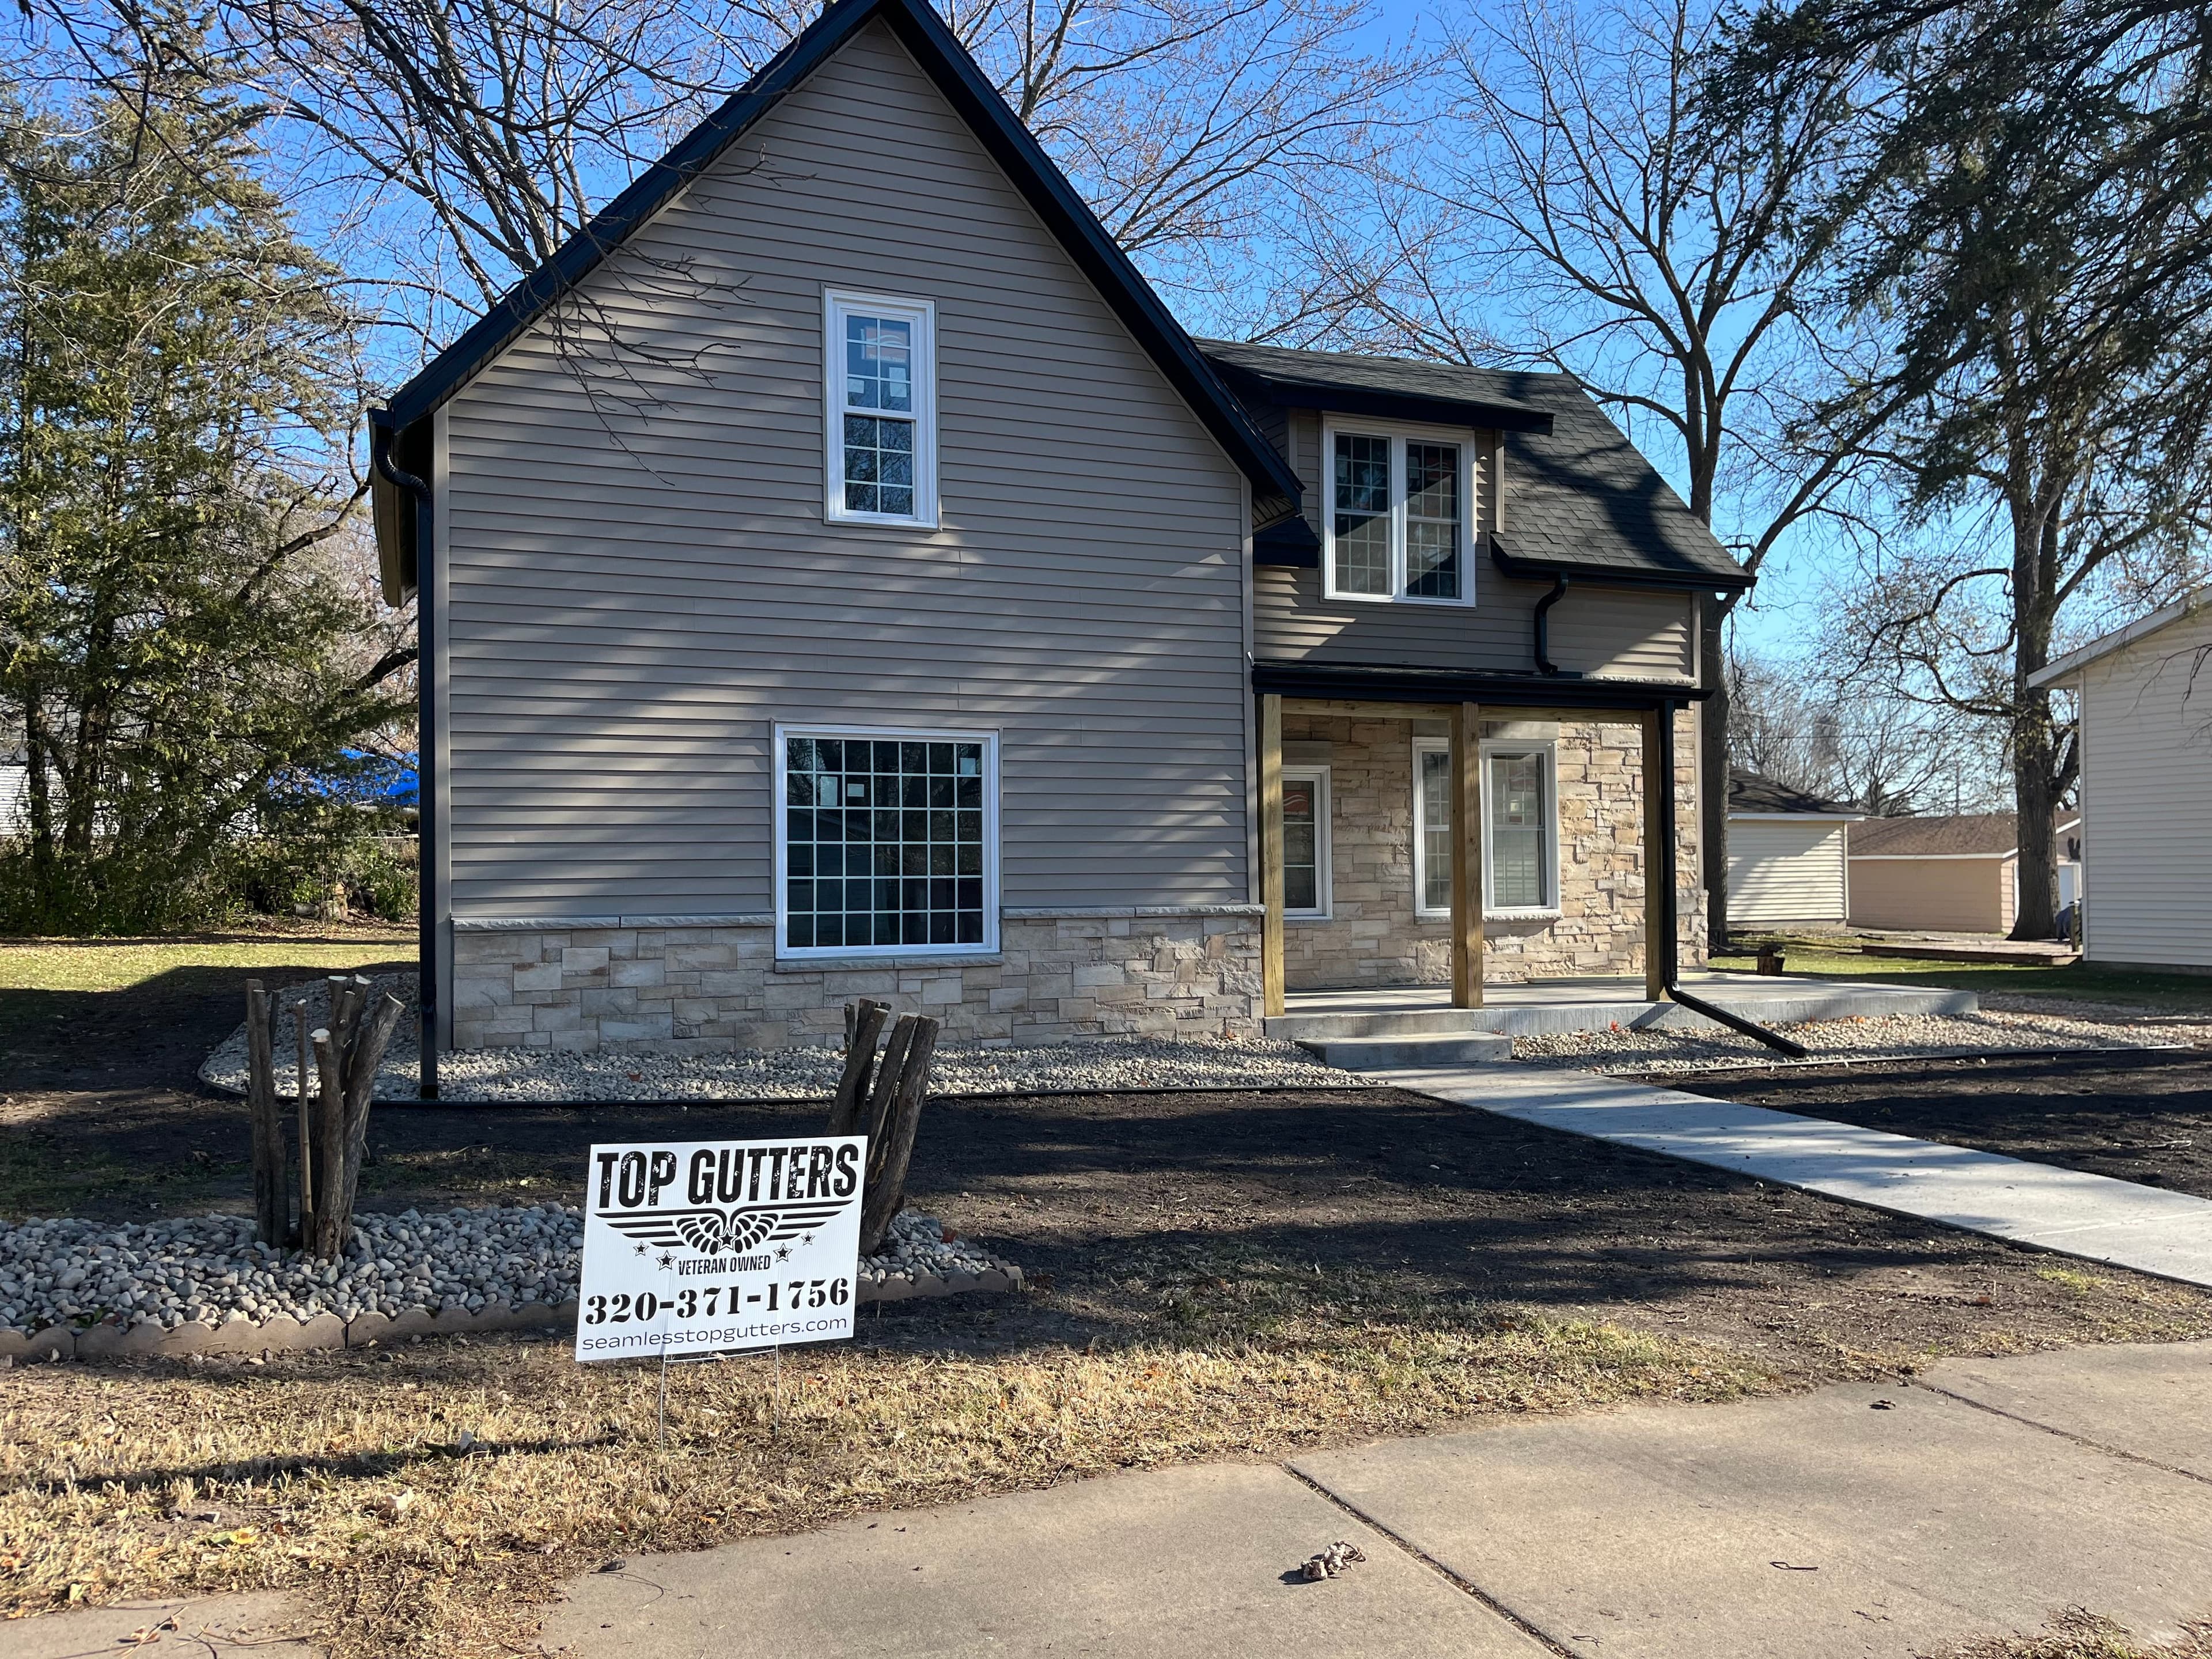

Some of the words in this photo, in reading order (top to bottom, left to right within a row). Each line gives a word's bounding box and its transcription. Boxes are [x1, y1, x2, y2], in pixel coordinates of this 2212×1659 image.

[597, 1151, 677, 1209] TOP
[688, 1143, 859, 1205] GUTTERS
[679, 1257, 726, 1276] VETERAN
[730, 1255, 771, 1272] OWNED
[585, 1278, 849, 1324] 320-371-1756
[582, 1317, 847, 1350] seamlesstopgutters.com
